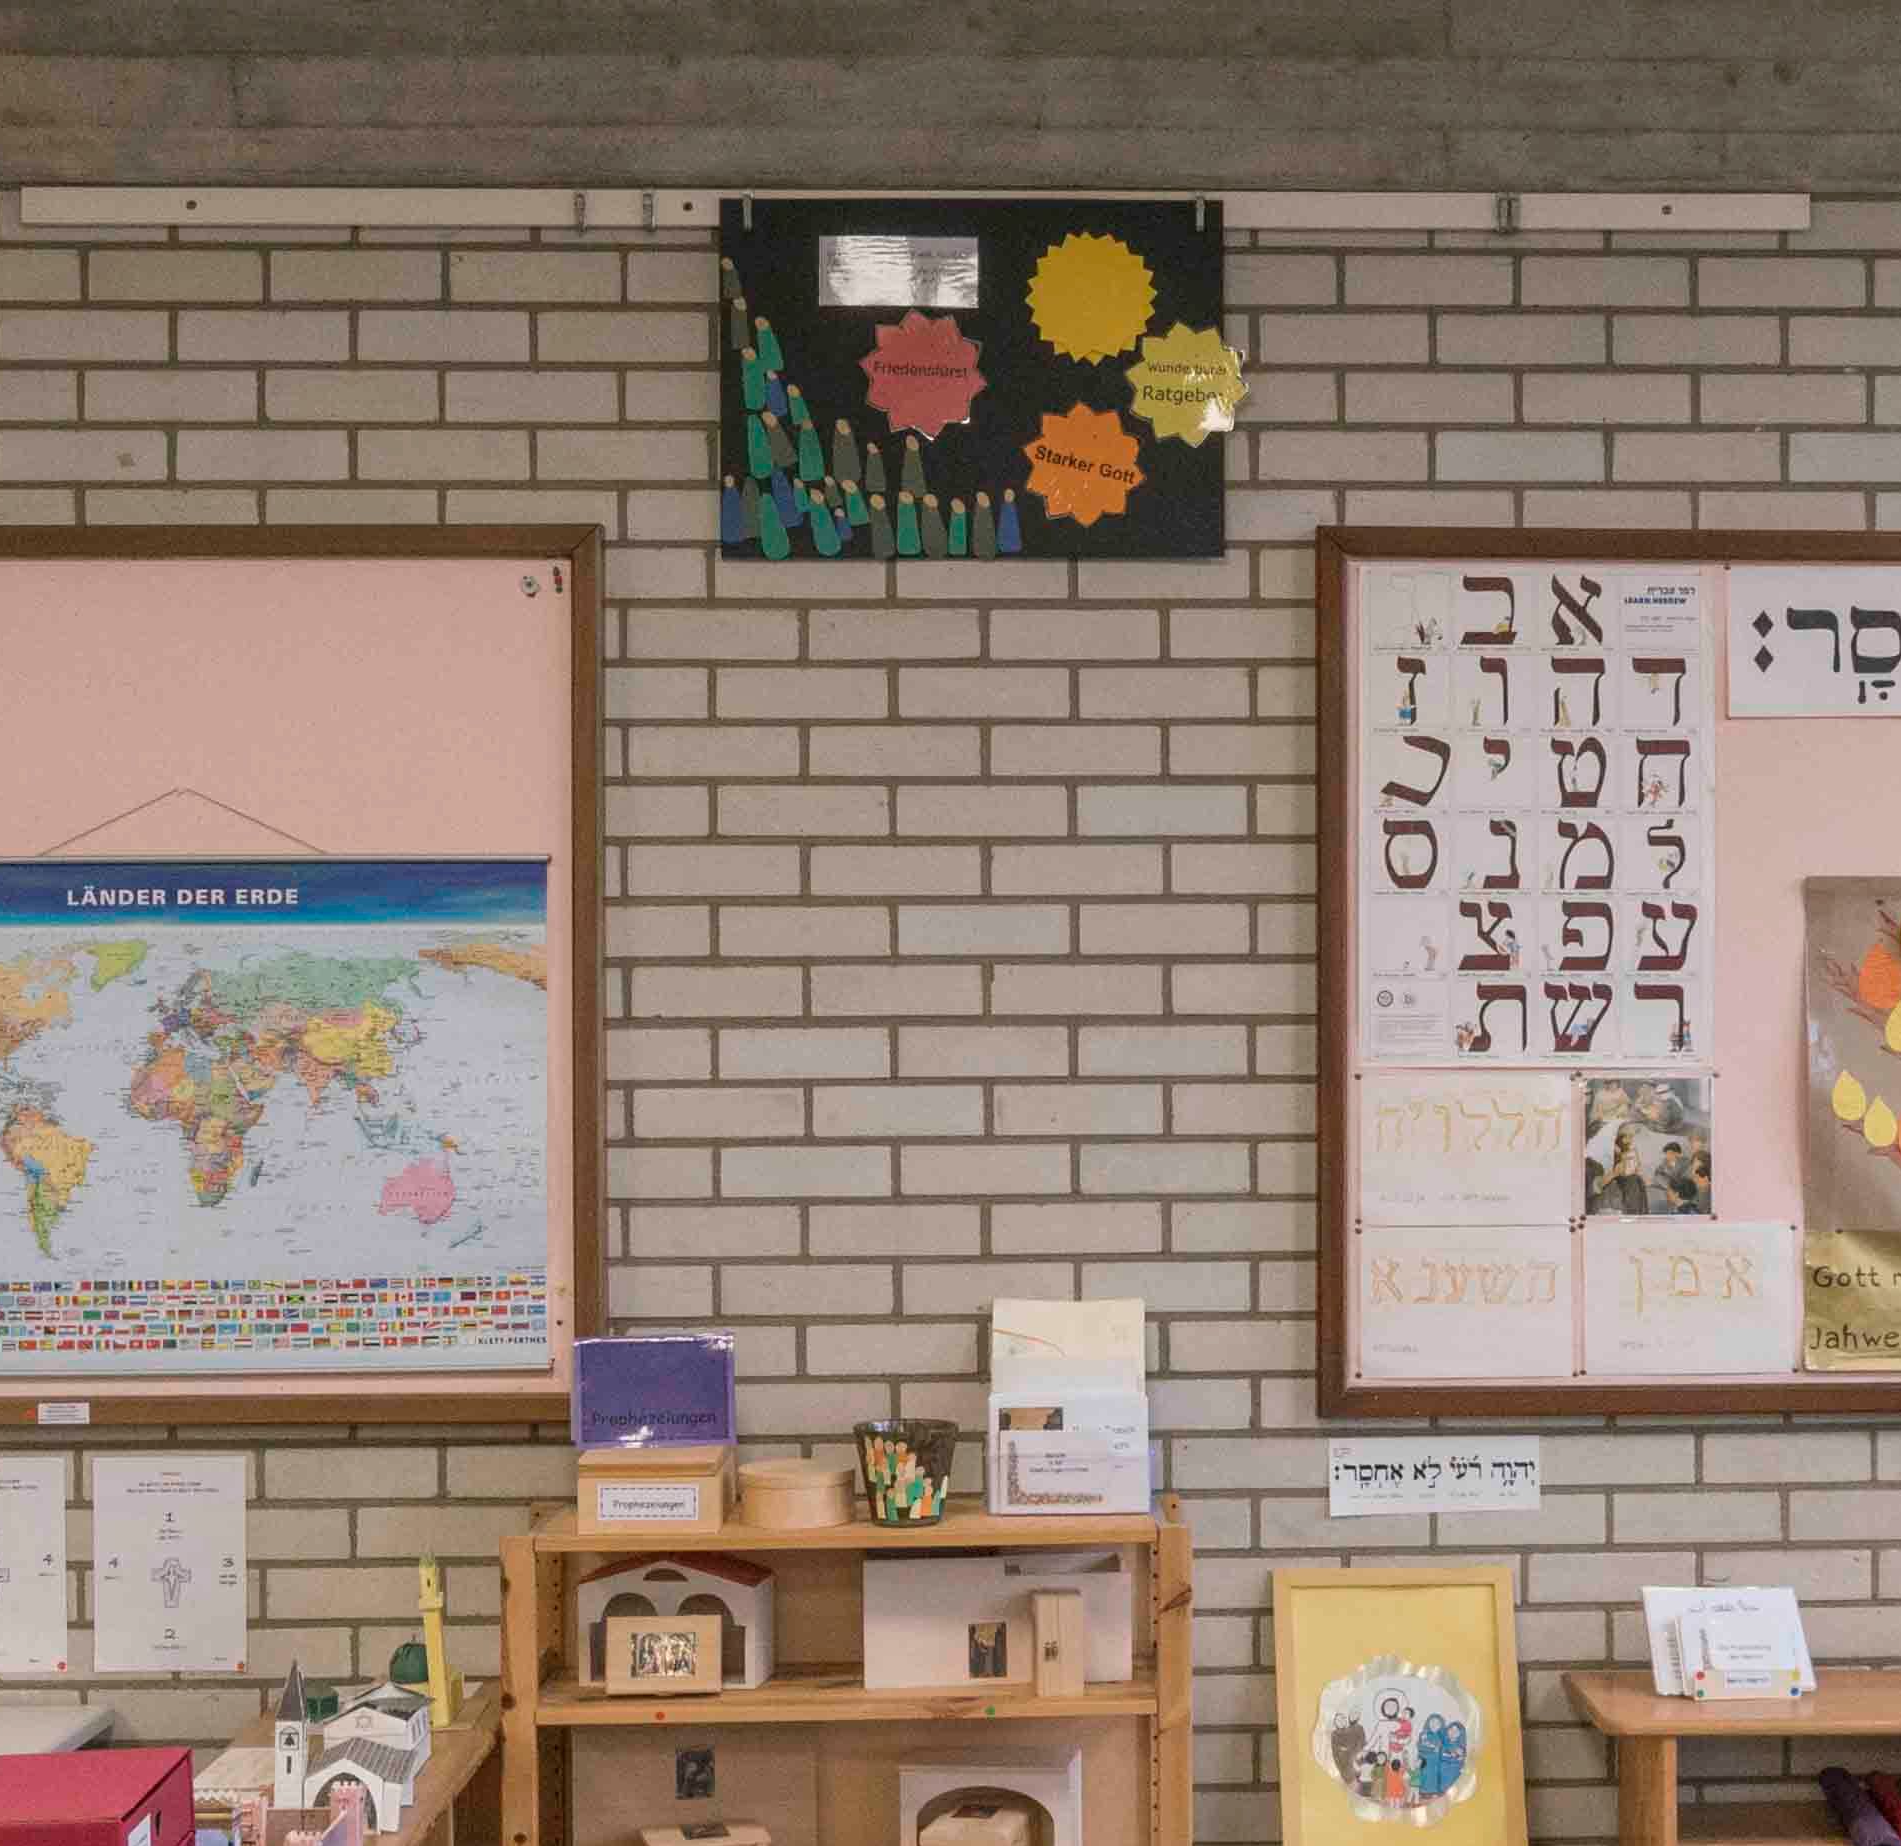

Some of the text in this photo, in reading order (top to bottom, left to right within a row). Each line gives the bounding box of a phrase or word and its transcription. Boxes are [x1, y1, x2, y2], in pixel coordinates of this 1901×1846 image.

[1034, 445, 1136, 484] Starker Gott
[1550, 574, 1603, 646] א
[1551, 655, 1605, 727] ה
[1557, 819, 1615, 890] מ
[1647, 818, 1686, 890] ל
[67, 885, 299, 905] LÄNDER DER ERDE
[1637, 901, 1698, 971] ע
[1467, 981, 1528, 1051] ת
[1543, 981, 1613, 1052] ש
[1811, 1265, 1879, 1288] Gott
[592, 1409, 717, 1427] Prophezeiungen
[164, 1512, 175, 1523] 1
[612, 1499, 685, 1511] Prophezeiungen
[42, 1554, 54, 1566] 4
[107, 1557, 235, 1569] 4 3
[163, 1628, 177, 1640] 2
